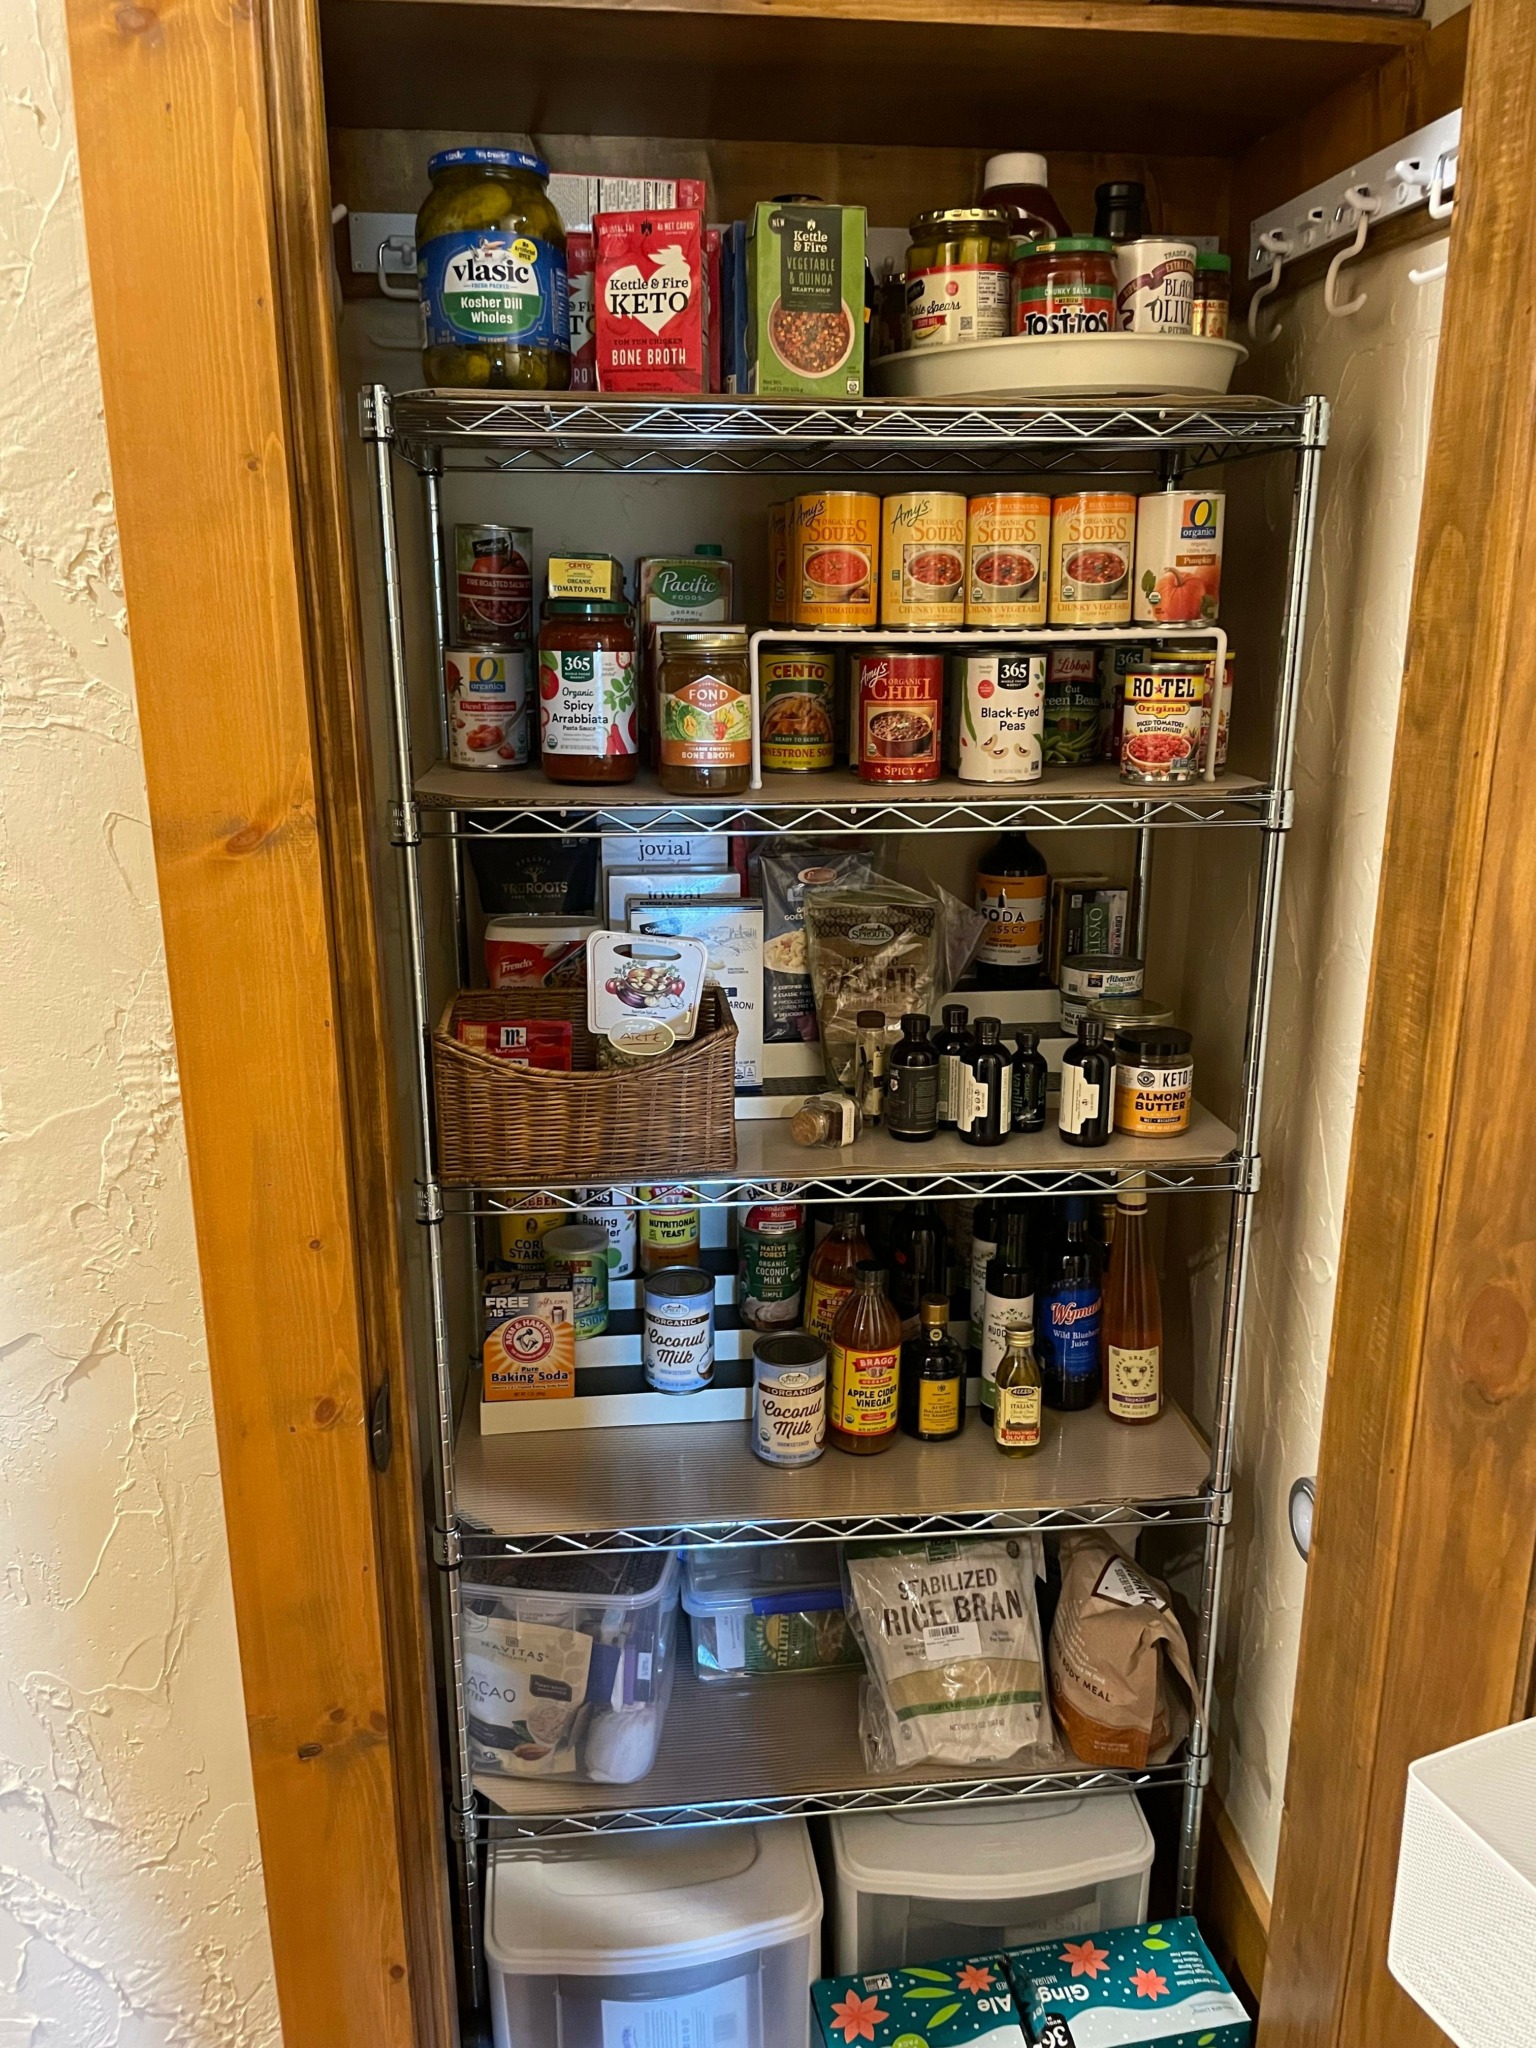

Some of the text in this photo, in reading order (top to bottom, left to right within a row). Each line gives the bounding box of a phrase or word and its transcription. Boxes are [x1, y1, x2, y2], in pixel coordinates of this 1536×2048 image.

[664, 222, 694, 230] NET CARBS
[772, 218, 785, 227] NEW
[793, 230, 828, 243] Kettle
[793, 242, 828, 253] & Fire
[1164, 250, 1186, 259] TRADER
[786, 256, 835, 272] VEGETABLE
[1166, 260, 1185, 272] EXTRA
[453, 259, 529, 284] vlasic
[789, 271, 833, 286] & QUINOA
[610, 278, 688, 291] Kettle & Fire
[1044, 286, 1092, 296] CHUNKY SALSA
[1123, 282, 1138, 298] RIPE
[461, 296, 523, 310] Kosher Dill
[610, 292, 688, 315] KETO
[926, 301, 962, 316] Spears
[471, 311, 513, 325] Wholes
[612, 348, 686, 366] BONE BROTH
[798, 500, 826, 527] Amy's
[891, 500, 931, 535] Amy's
[1190, 499, 1212, 527] O
[822, 518, 855, 526] ORGANIC
[809, 519, 867, 542] SOUPS
[912, 518, 965, 542] SOUPS
[978, 519, 1036, 542] SOUPS
[1069, 518, 1127, 541] SOUPS
[1183, 528, 1214, 538] organics
[1183, 557, 1213, 565] Pumpkin
[480, 580, 508, 588] ROASTED
[553, 585, 607, 594] TOMATO PASTE
[659, 571, 717, 594] Pacific
[825, 606, 854, 614] TOMATO
[899, 606, 934, 614] CHUNKY
[968, 606, 994, 614] CHUNKY
[1058, 604, 1090, 612] CHUNKY
[564, 656, 590, 672] 365
[1055, 657, 1091, 674] Libby's
[1117, 652, 1141, 666] 365
[476, 657, 499, 684] O
[772, 664, 825, 679] CENTO
[860, 662, 890, 692] Amy's
[1001, 662, 1027, 679] 365
[471, 682, 504, 691] organics
[871, 678, 931, 700] CHILI
[888, 678, 921, 686] ORGANIC
[562, 687, 595, 701] Organic
[689, 689, 729, 701] FOND
[1065, 685, 1080, 694] Cut
[564, 700, 594, 712] Spicy
[981, 706, 1039, 720] Black-Eyed
[1138, 704, 1186, 713] Original
[552, 714, 609, 725] Arrabbiata
[999, 721, 1026, 731] Peas
[1136, 719, 1184, 728] DICED TOMATOES
[1144, 726, 1182, 734] GREEN CHILIES
[682, 751, 735, 760] BONE BROTH
[884, 765, 916, 777] SPICY
[638, 839, 691, 861] jovial
[981, 907, 1025, 923] SODA
[852, 929, 892, 939] SPROUTS
[1114, 916, 1122, 938] CROWN
[501, 957, 535, 973] French's
[1106, 975, 1136, 984] Albacore
[619, 1032, 661, 1043] ARTE
[1163, 1071, 1188, 1088] KETO
[1013, 1073, 1023, 1115] vanilla
[1136, 1091, 1186, 1101] ALMOND
[1135, 1100, 1186, 1112] BUTTER
[747, 1183, 779, 1200] EAGLE
[759, 1203, 797, 1212] Condensed
[582, 1215, 618, 1227] Baking
[649, 1216, 696, 1229] NUTRITIONAL
[661, 1229, 686, 1238] YEAST
[756, 1267, 790, 1276] COCONUT
[763, 1276, 782, 1285] MILK
[485, 1295, 530, 1309] FREE
[578, 1314, 605, 1328] SODA
[654, 1318, 697, 1326] ORGANIC
[505, 1319, 552, 1345] ARM & HAMMER
[648, 1329, 706, 1348] Coconut
[1053, 1329, 1071, 1340] Wild
[1071, 1339, 1089, 1349] Juice
[657, 1348, 694, 1368] Milk
[860, 1357, 894, 1368] BRAGG
[491, 1371, 569, 1384] Baking Soda
[771, 1388, 816, 1398] ORGANIC
[847, 1384, 897, 1398] APPLE CIDER
[762, 1398, 822, 1419] Coconut
[856, 1396, 891, 1408] VINEGAR
[773, 1420, 812, 1439] Milk
[898, 1567, 998, 1602] STABILIZED
[1113, 1567, 1136, 1597] SUPERFOOD
[883, 1589, 1023, 1636] RICE BRAN
[481, 1640, 545, 1663] NAVITAS
[1062, 1657, 1111, 1703] BODY MEAL
[1092, 1673, 1105, 1685] ONE
[467, 1676, 516, 1704] ACAO
[977, 1993, 1011, 2015] Ale
